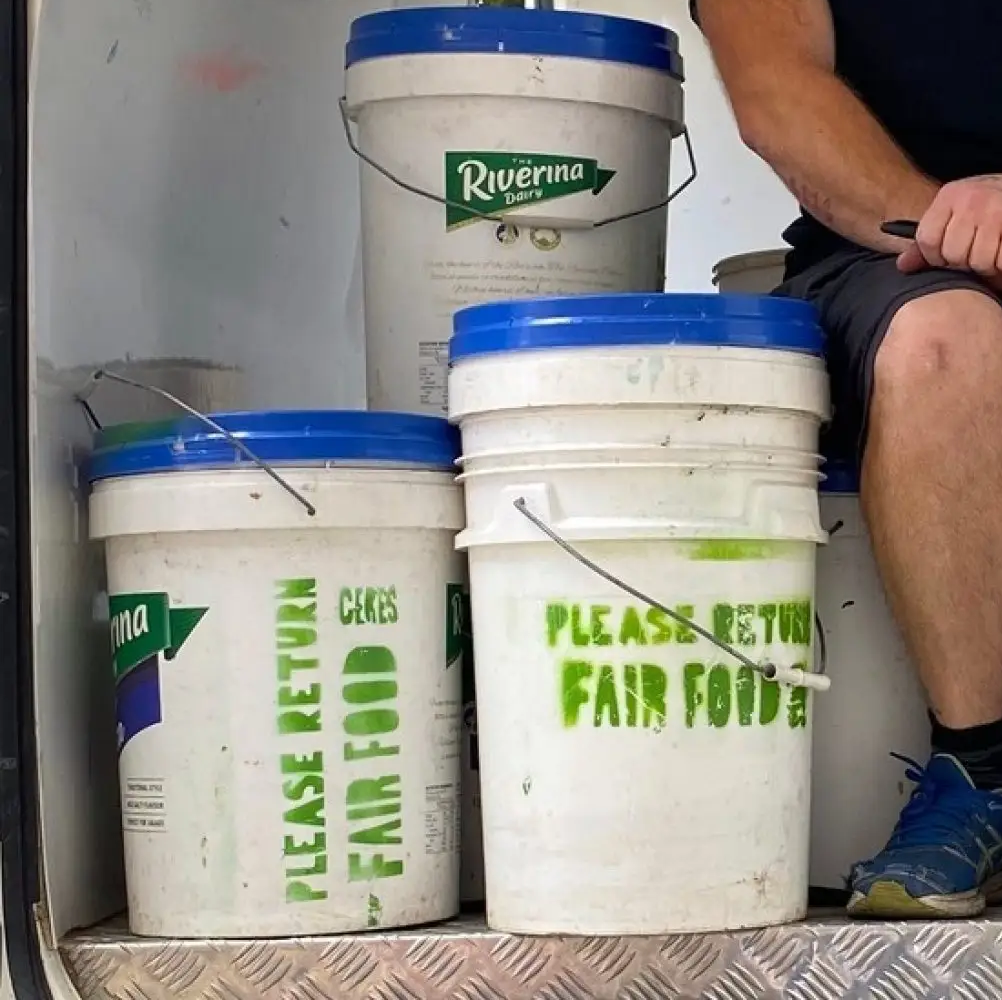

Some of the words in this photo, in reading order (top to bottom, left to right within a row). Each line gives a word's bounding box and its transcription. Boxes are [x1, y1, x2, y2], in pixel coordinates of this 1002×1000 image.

[457, 159, 585, 201] Riverina
[504, 188, 544, 205] Dairy
[274, 577, 322, 735] RETURN
[546, 603, 698, 647] PLEASE
[342, 646, 400, 761] FOOD
[562, 661, 667, 728] FAIR
[683, 662, 781, 728] FOOD
[280, 751, 328, 903] PLEASE
[346, 774, 403, 882] FAIR
